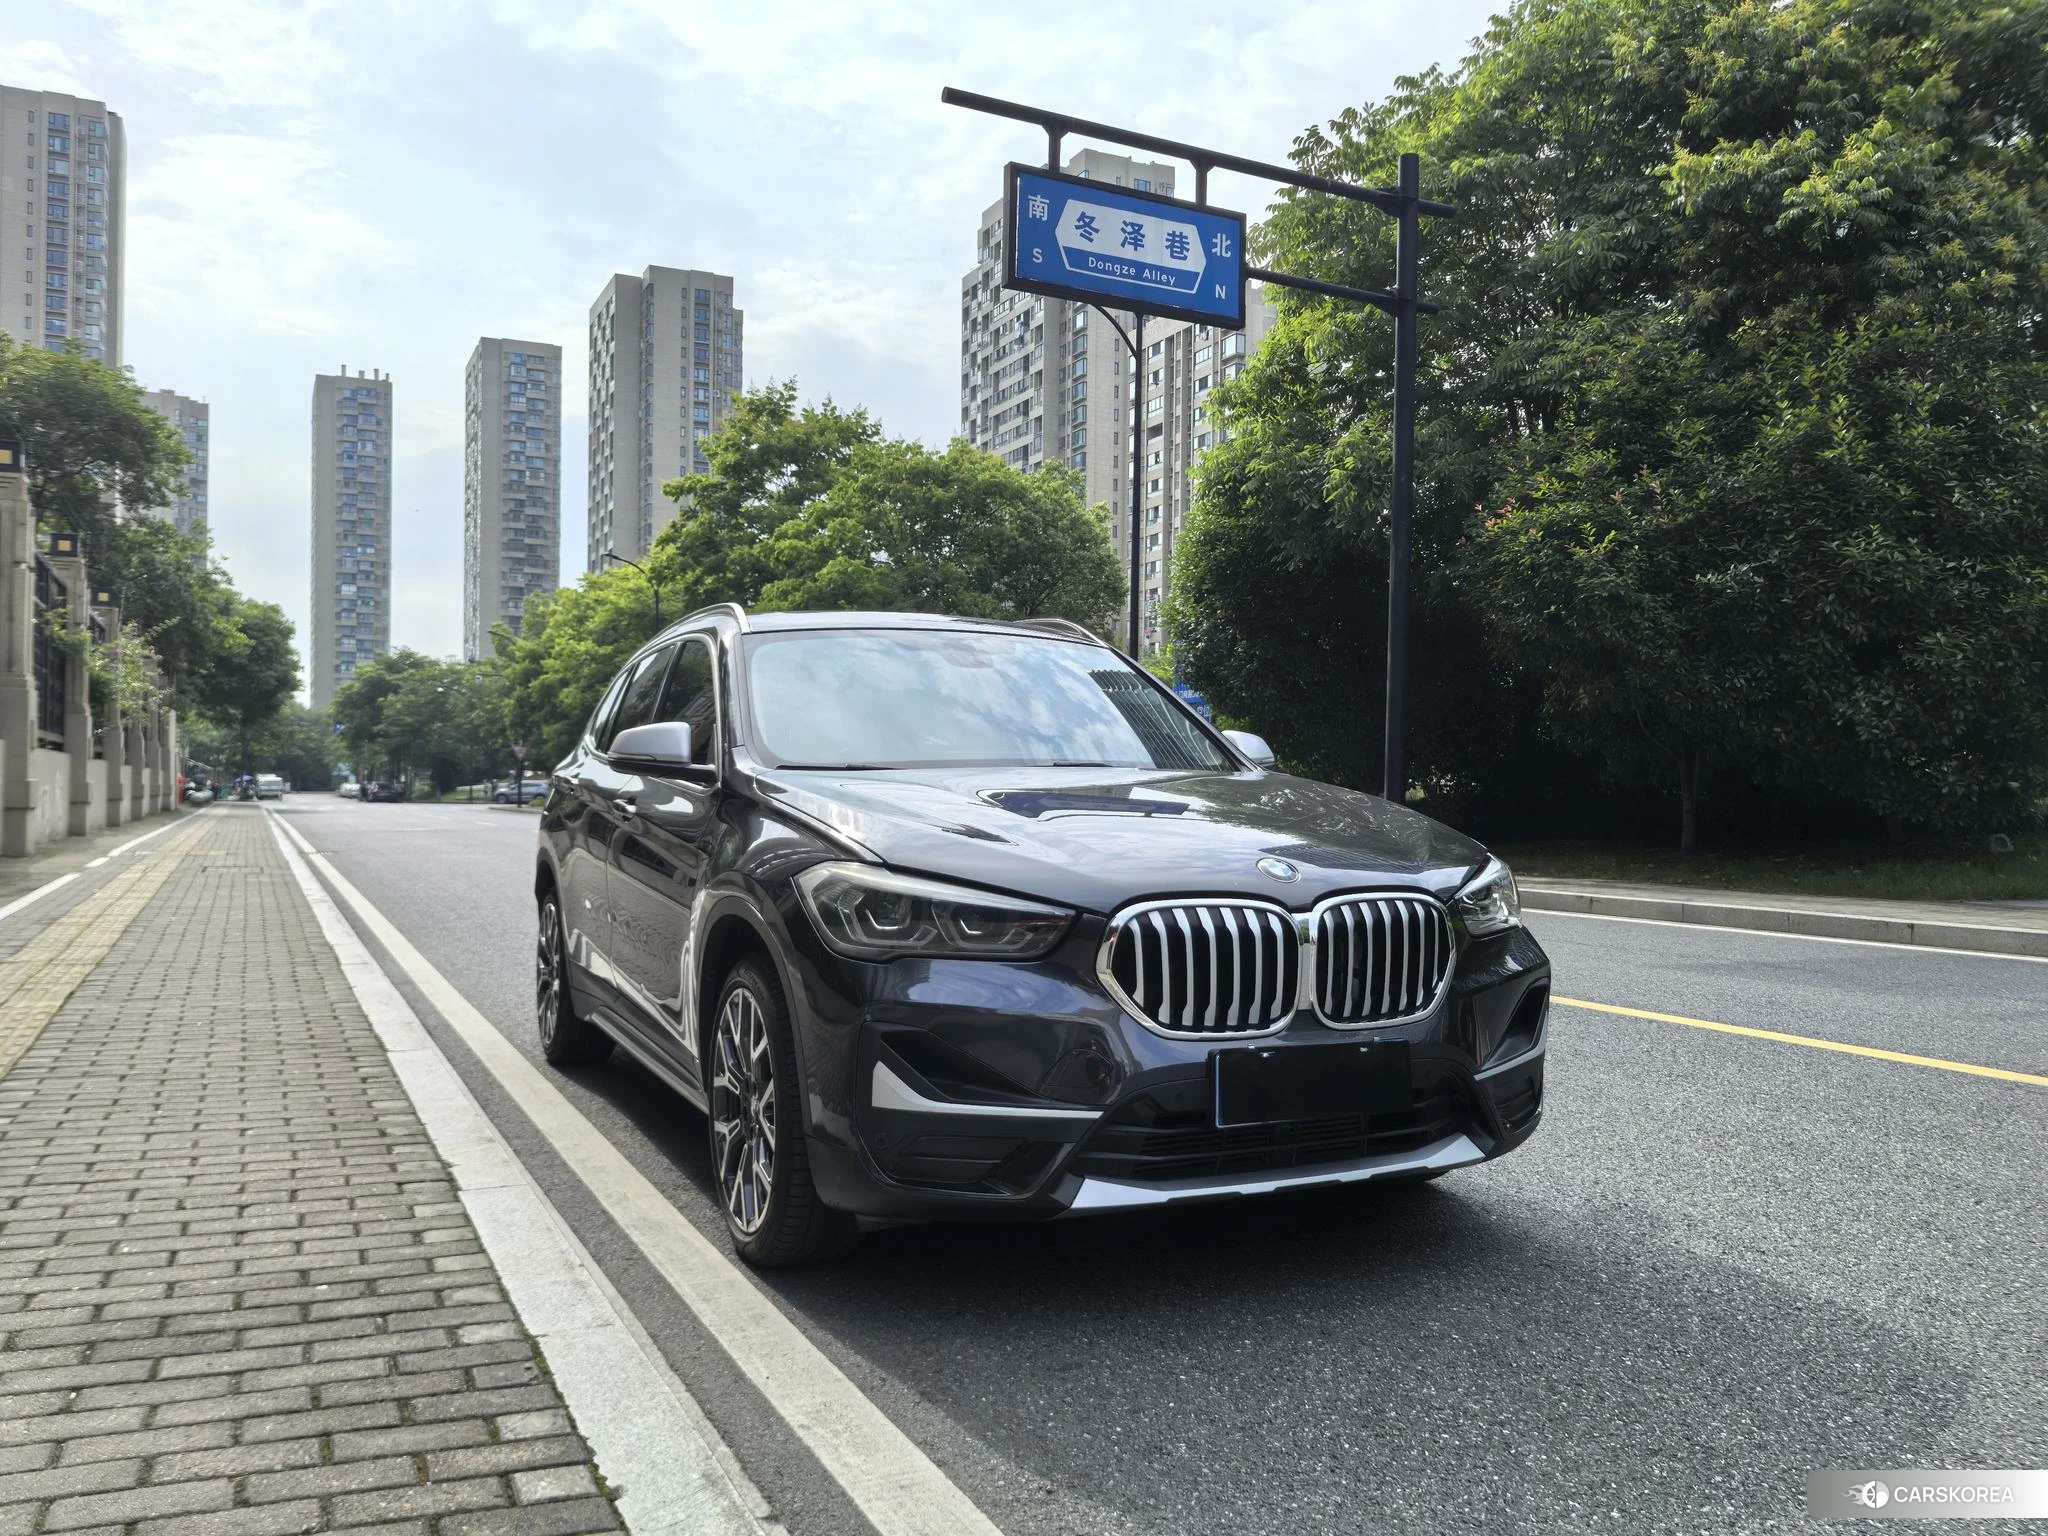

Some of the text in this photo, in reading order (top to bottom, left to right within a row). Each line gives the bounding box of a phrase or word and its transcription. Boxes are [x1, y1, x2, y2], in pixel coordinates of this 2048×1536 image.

[1028, 194, 1049, 222] 南
[1074, 211, 1190, 261] 冬泽巷
[1212, 232, 1232, 258] 北
[1032, 248, 1043, 264] S
[1088, 256, 1176, 286] Dongze Alley
[1215, 284, 1226, 299] N
